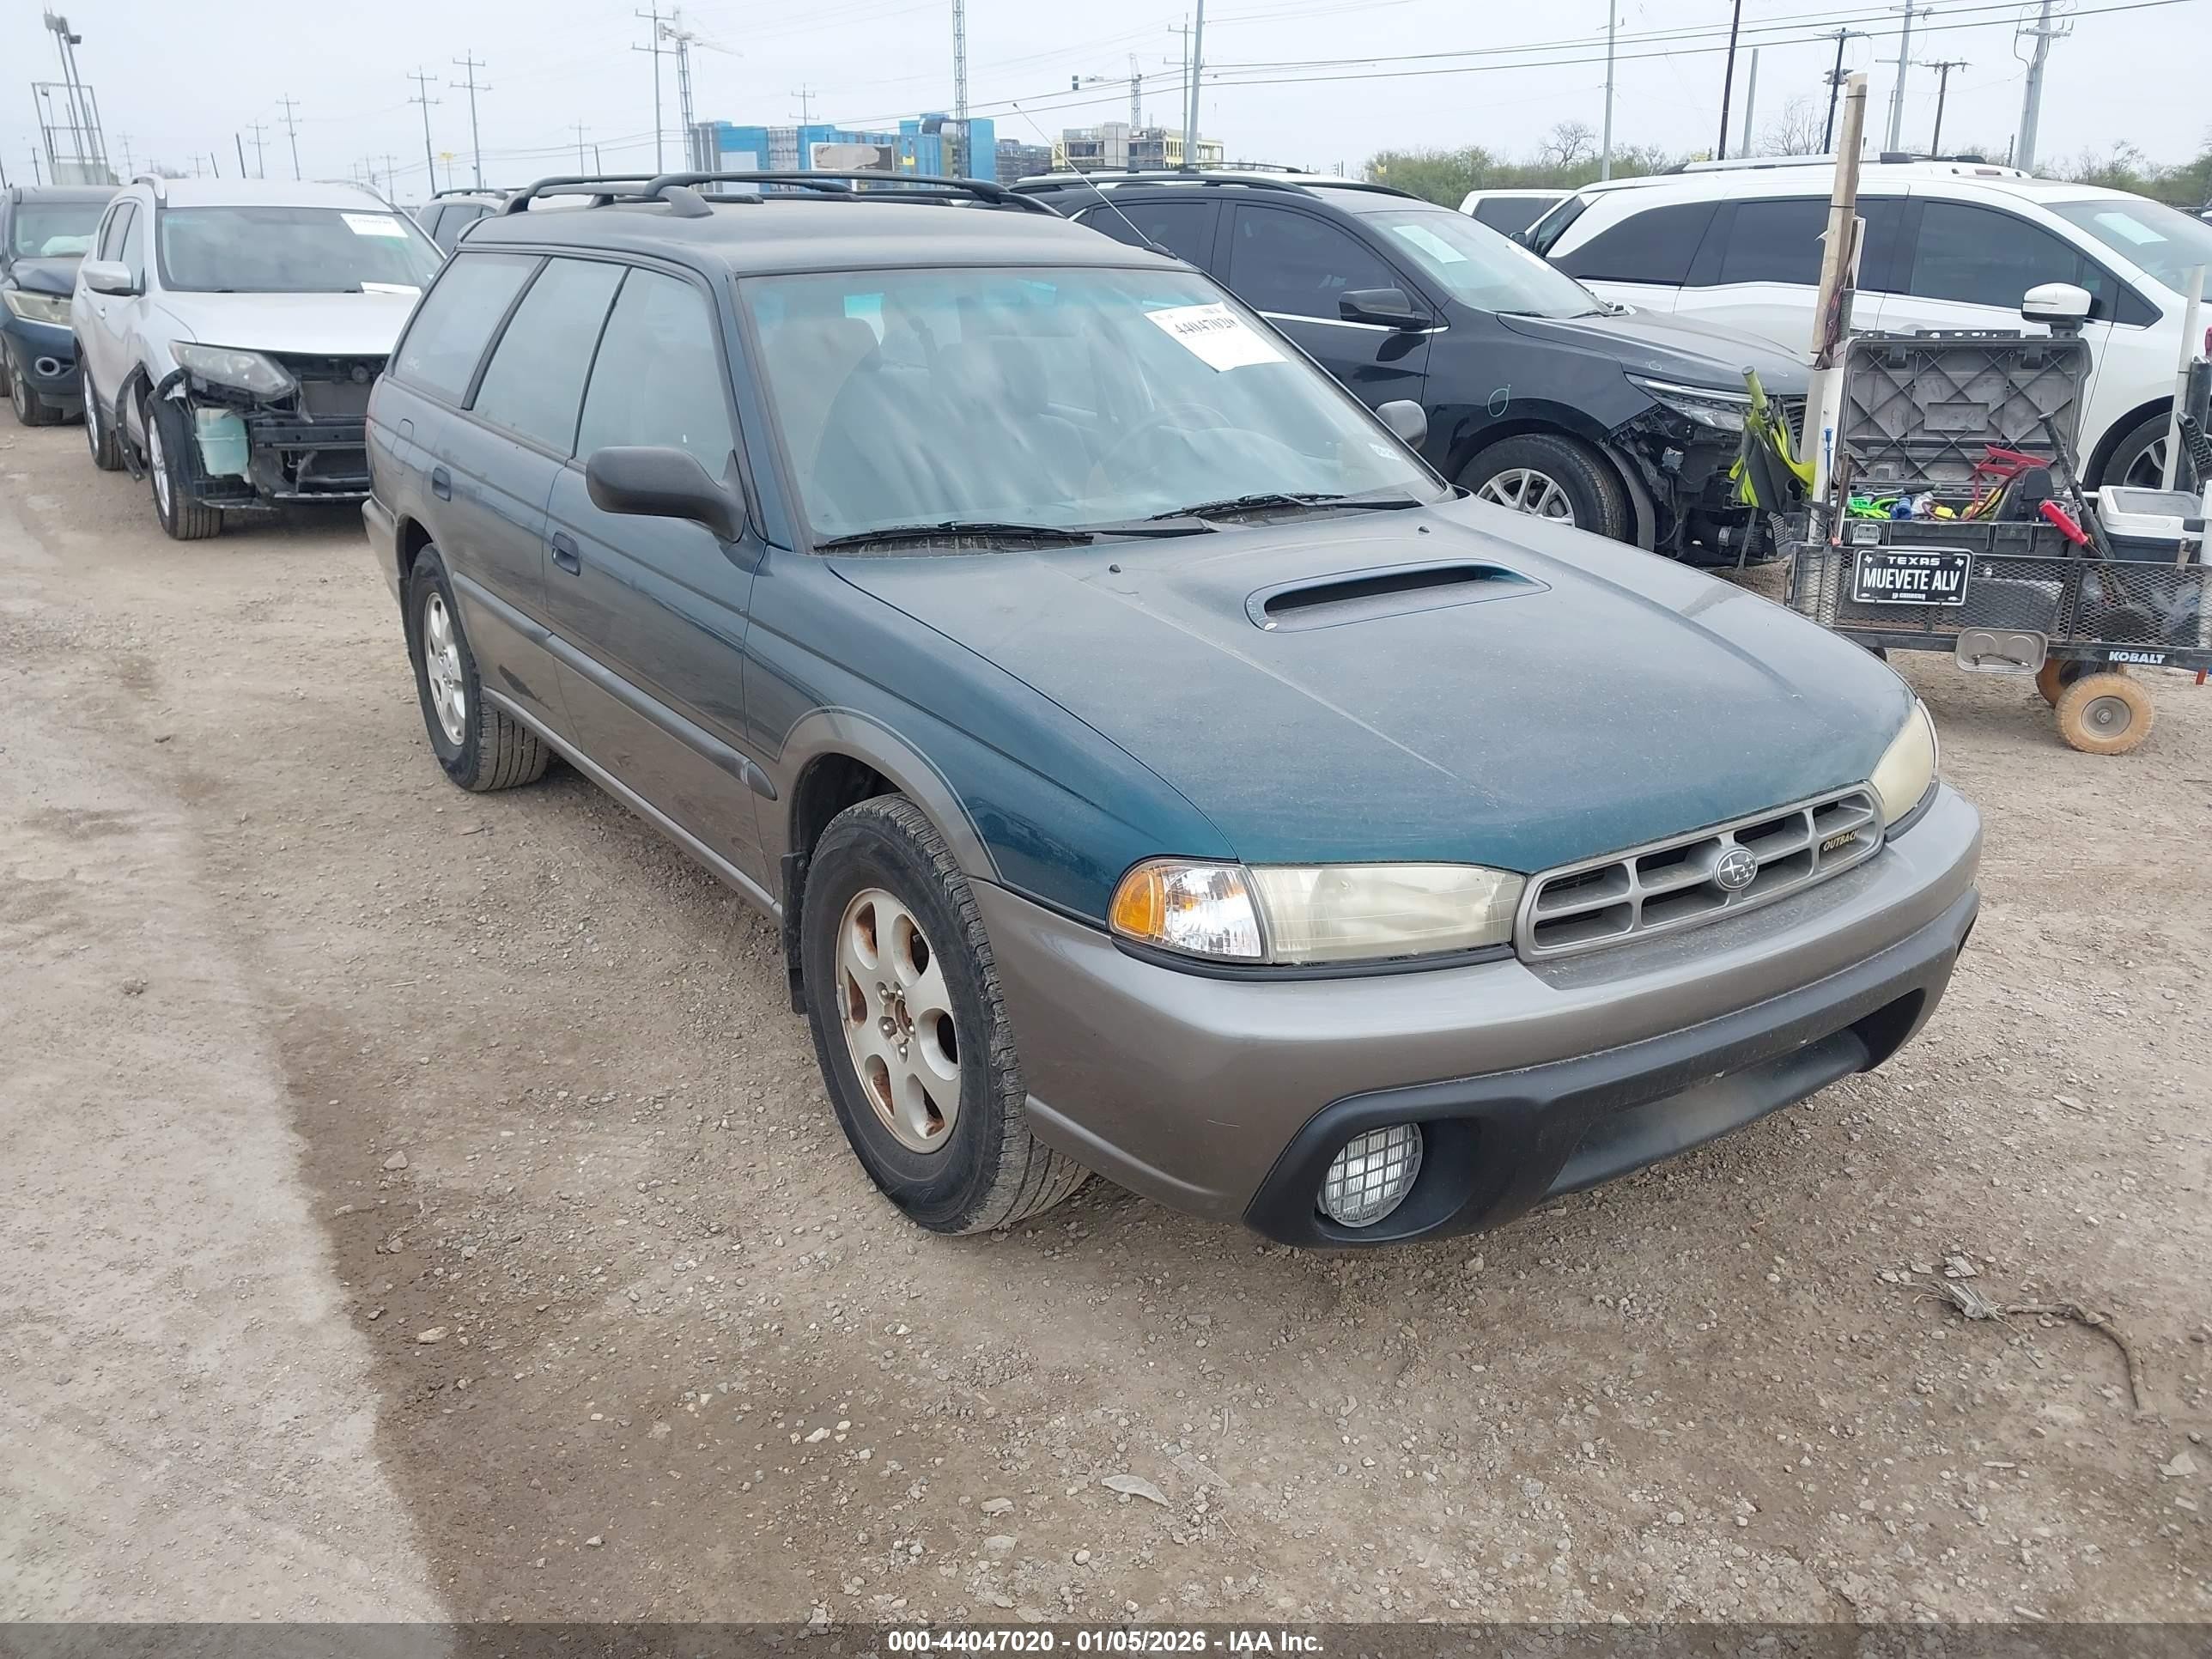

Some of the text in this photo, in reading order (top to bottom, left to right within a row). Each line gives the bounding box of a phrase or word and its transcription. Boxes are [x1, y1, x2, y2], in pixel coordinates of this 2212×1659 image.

[1888, 556, 1940, 565] TEXAS
[1863, 568, 1960, 591] MUEVETE ALV
[2108, 651, 2165, 664] KOBALT
[1823, 829, 1860, 852] OUTBACK
